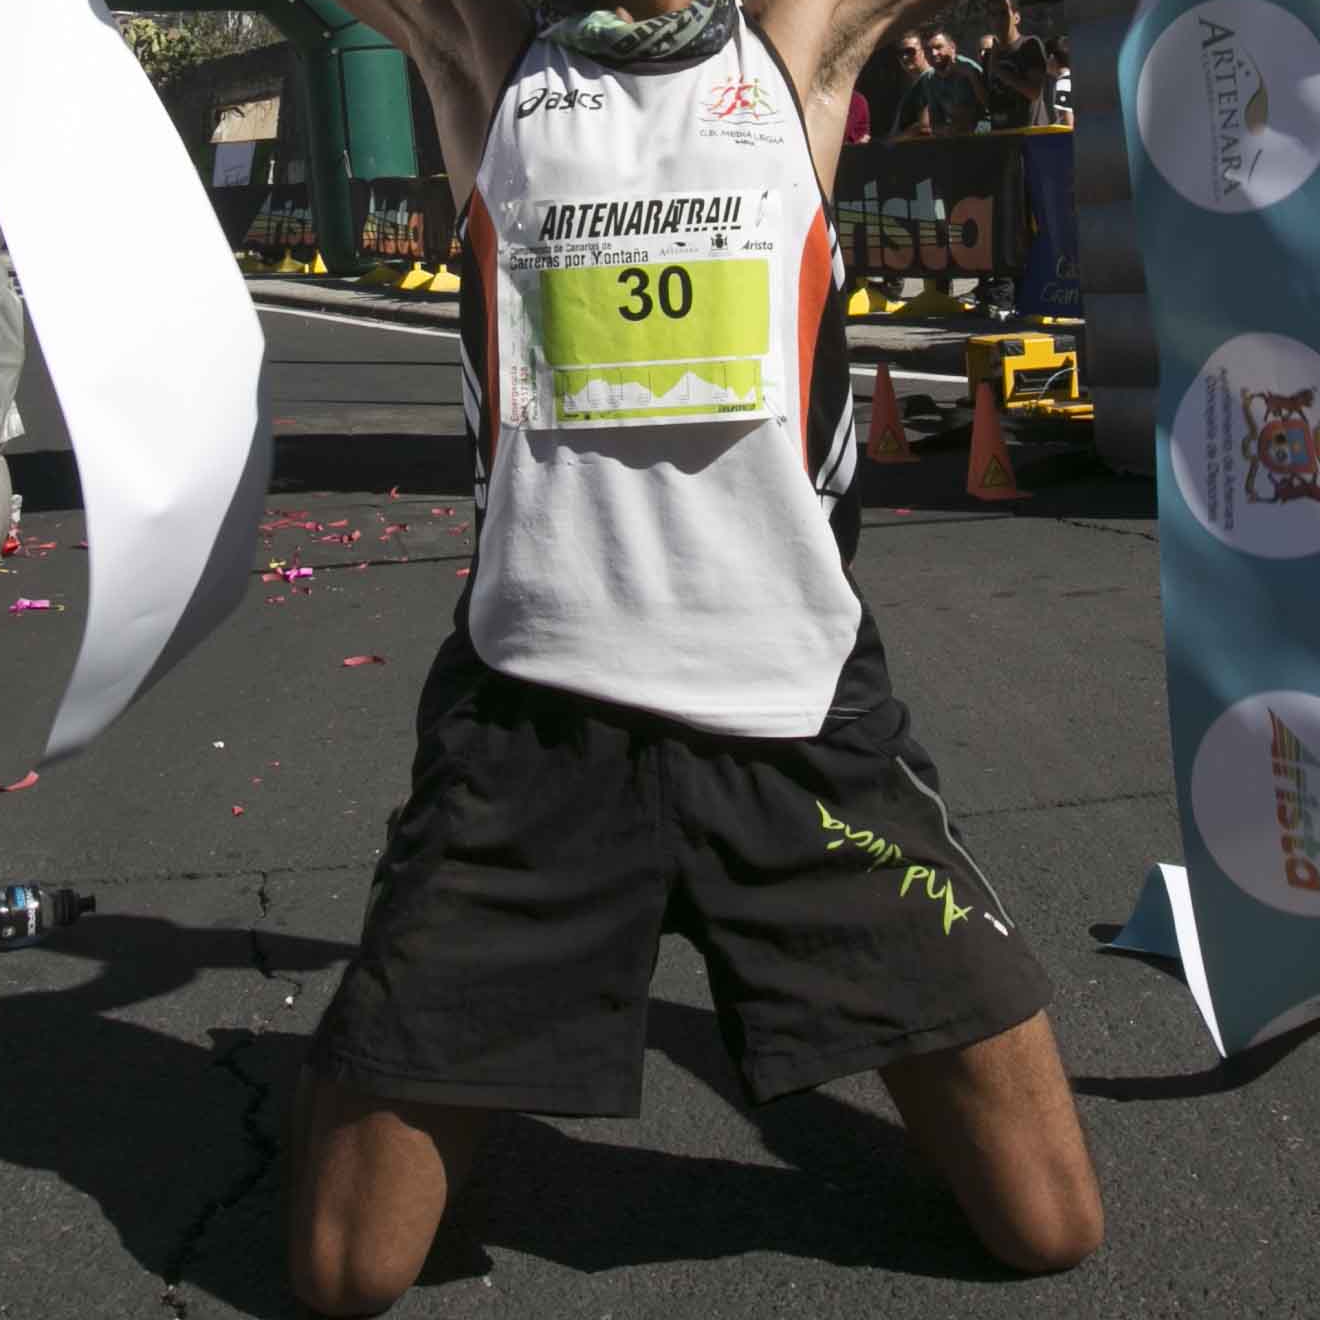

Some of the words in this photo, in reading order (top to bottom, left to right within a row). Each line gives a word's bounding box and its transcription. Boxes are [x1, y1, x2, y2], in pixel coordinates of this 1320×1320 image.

[1198, 16, 1242, 197] ARTENARA
[565, 254, 586, 269] por
[837, 179, 994, 272] rista
[616, 265, 693, 322] 30
